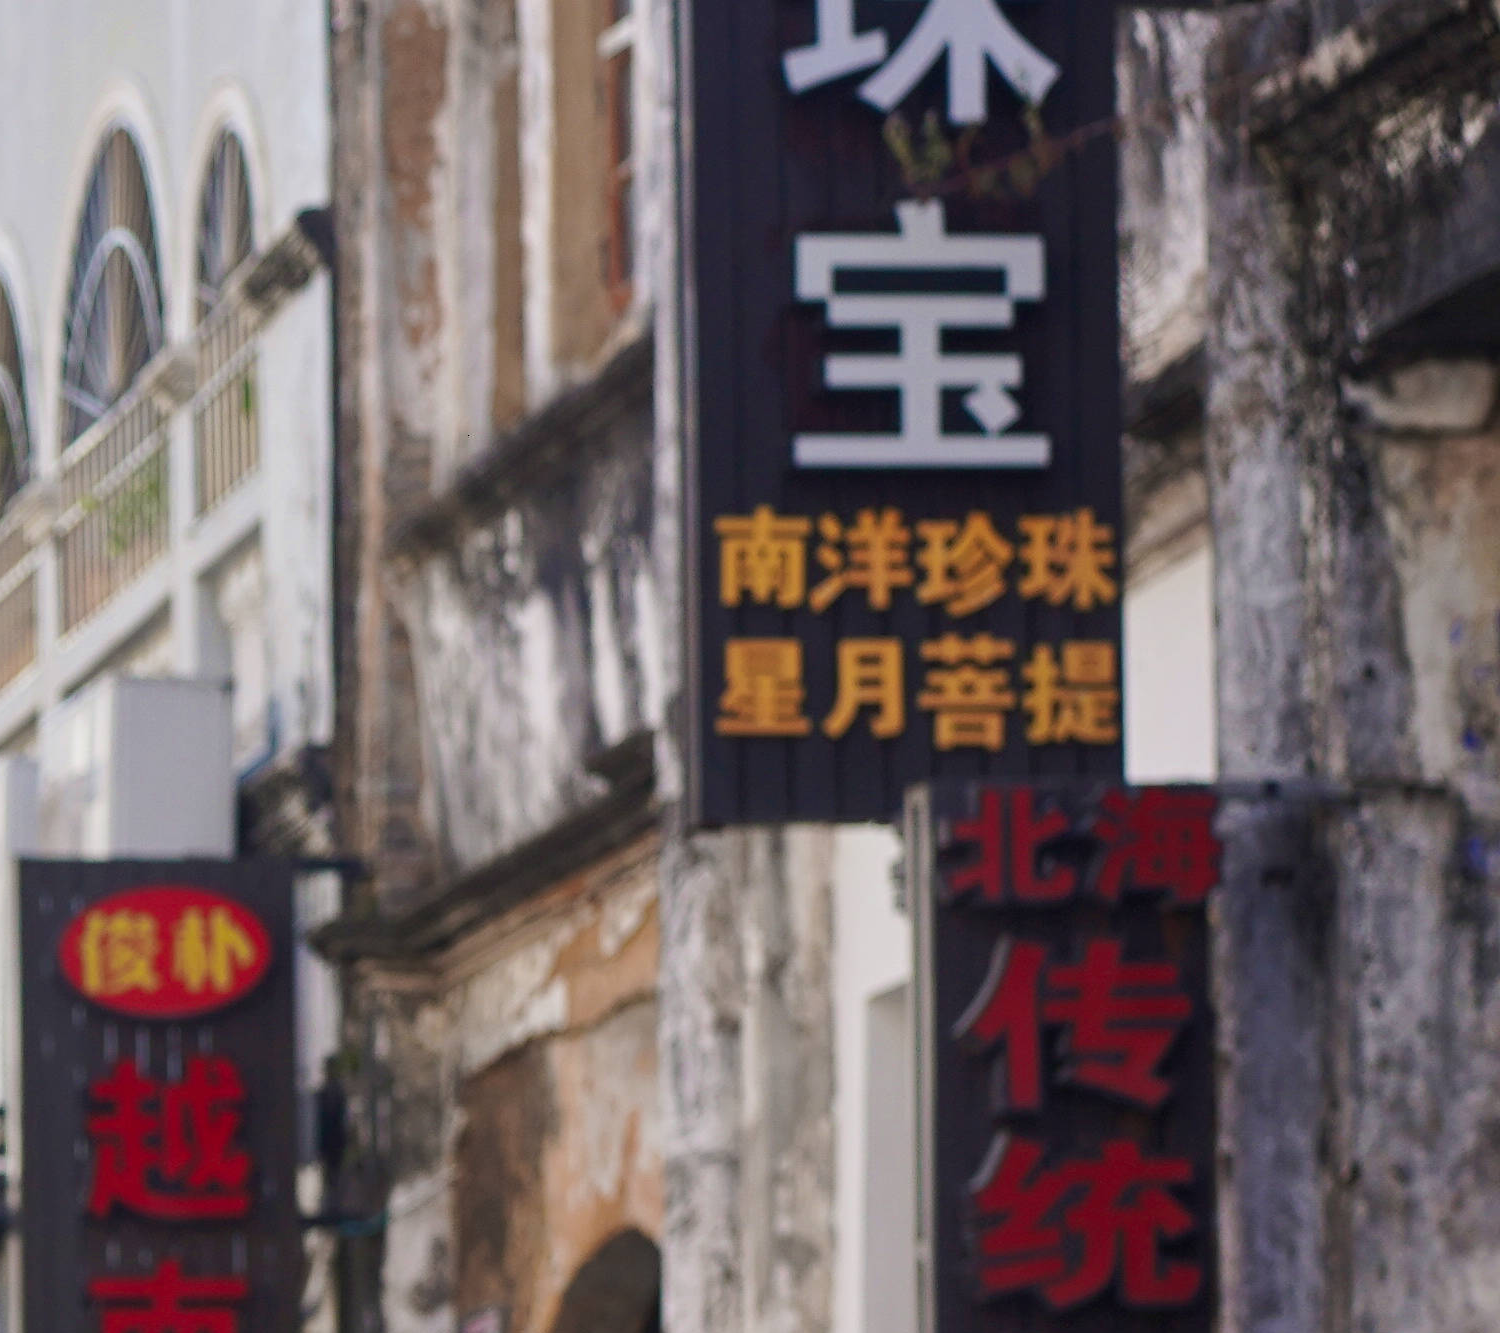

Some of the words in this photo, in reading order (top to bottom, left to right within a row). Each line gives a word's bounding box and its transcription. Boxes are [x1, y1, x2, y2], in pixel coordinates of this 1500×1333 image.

[713, 504, 1118, 617] 南洋珍珠
[714, 631, 1120, 752] 星月菩提
[945, 786, 1225, 904] 北海
